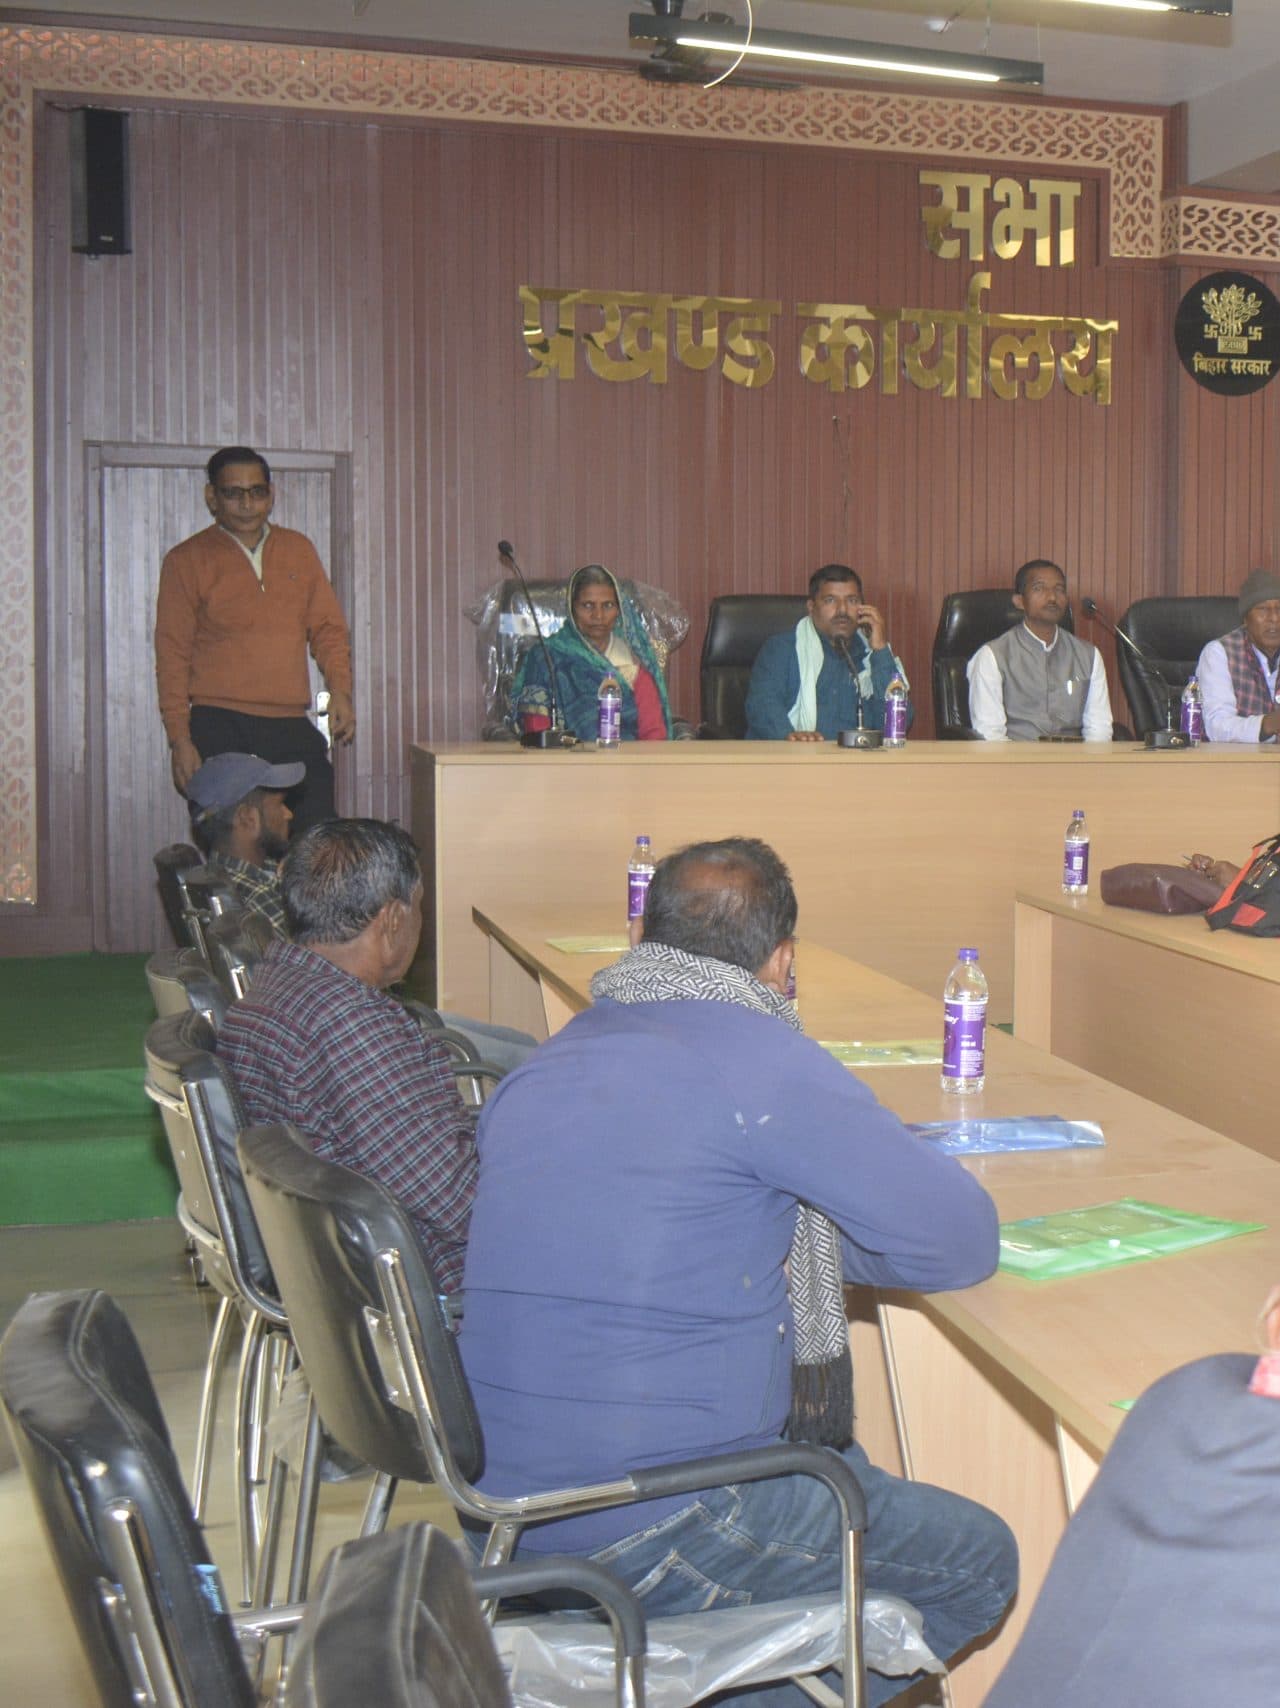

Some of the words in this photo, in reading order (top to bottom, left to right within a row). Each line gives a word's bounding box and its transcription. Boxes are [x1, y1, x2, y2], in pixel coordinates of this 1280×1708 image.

[919, 170, 1082, 267] सभा
[519, 284, 782, 388] प्रखण्ड
[796, 271, 1119, 405] कार्यालय
[1192, 351, 1229, 376] बिहार
[1230, 358, 1272, 376] सरकार
